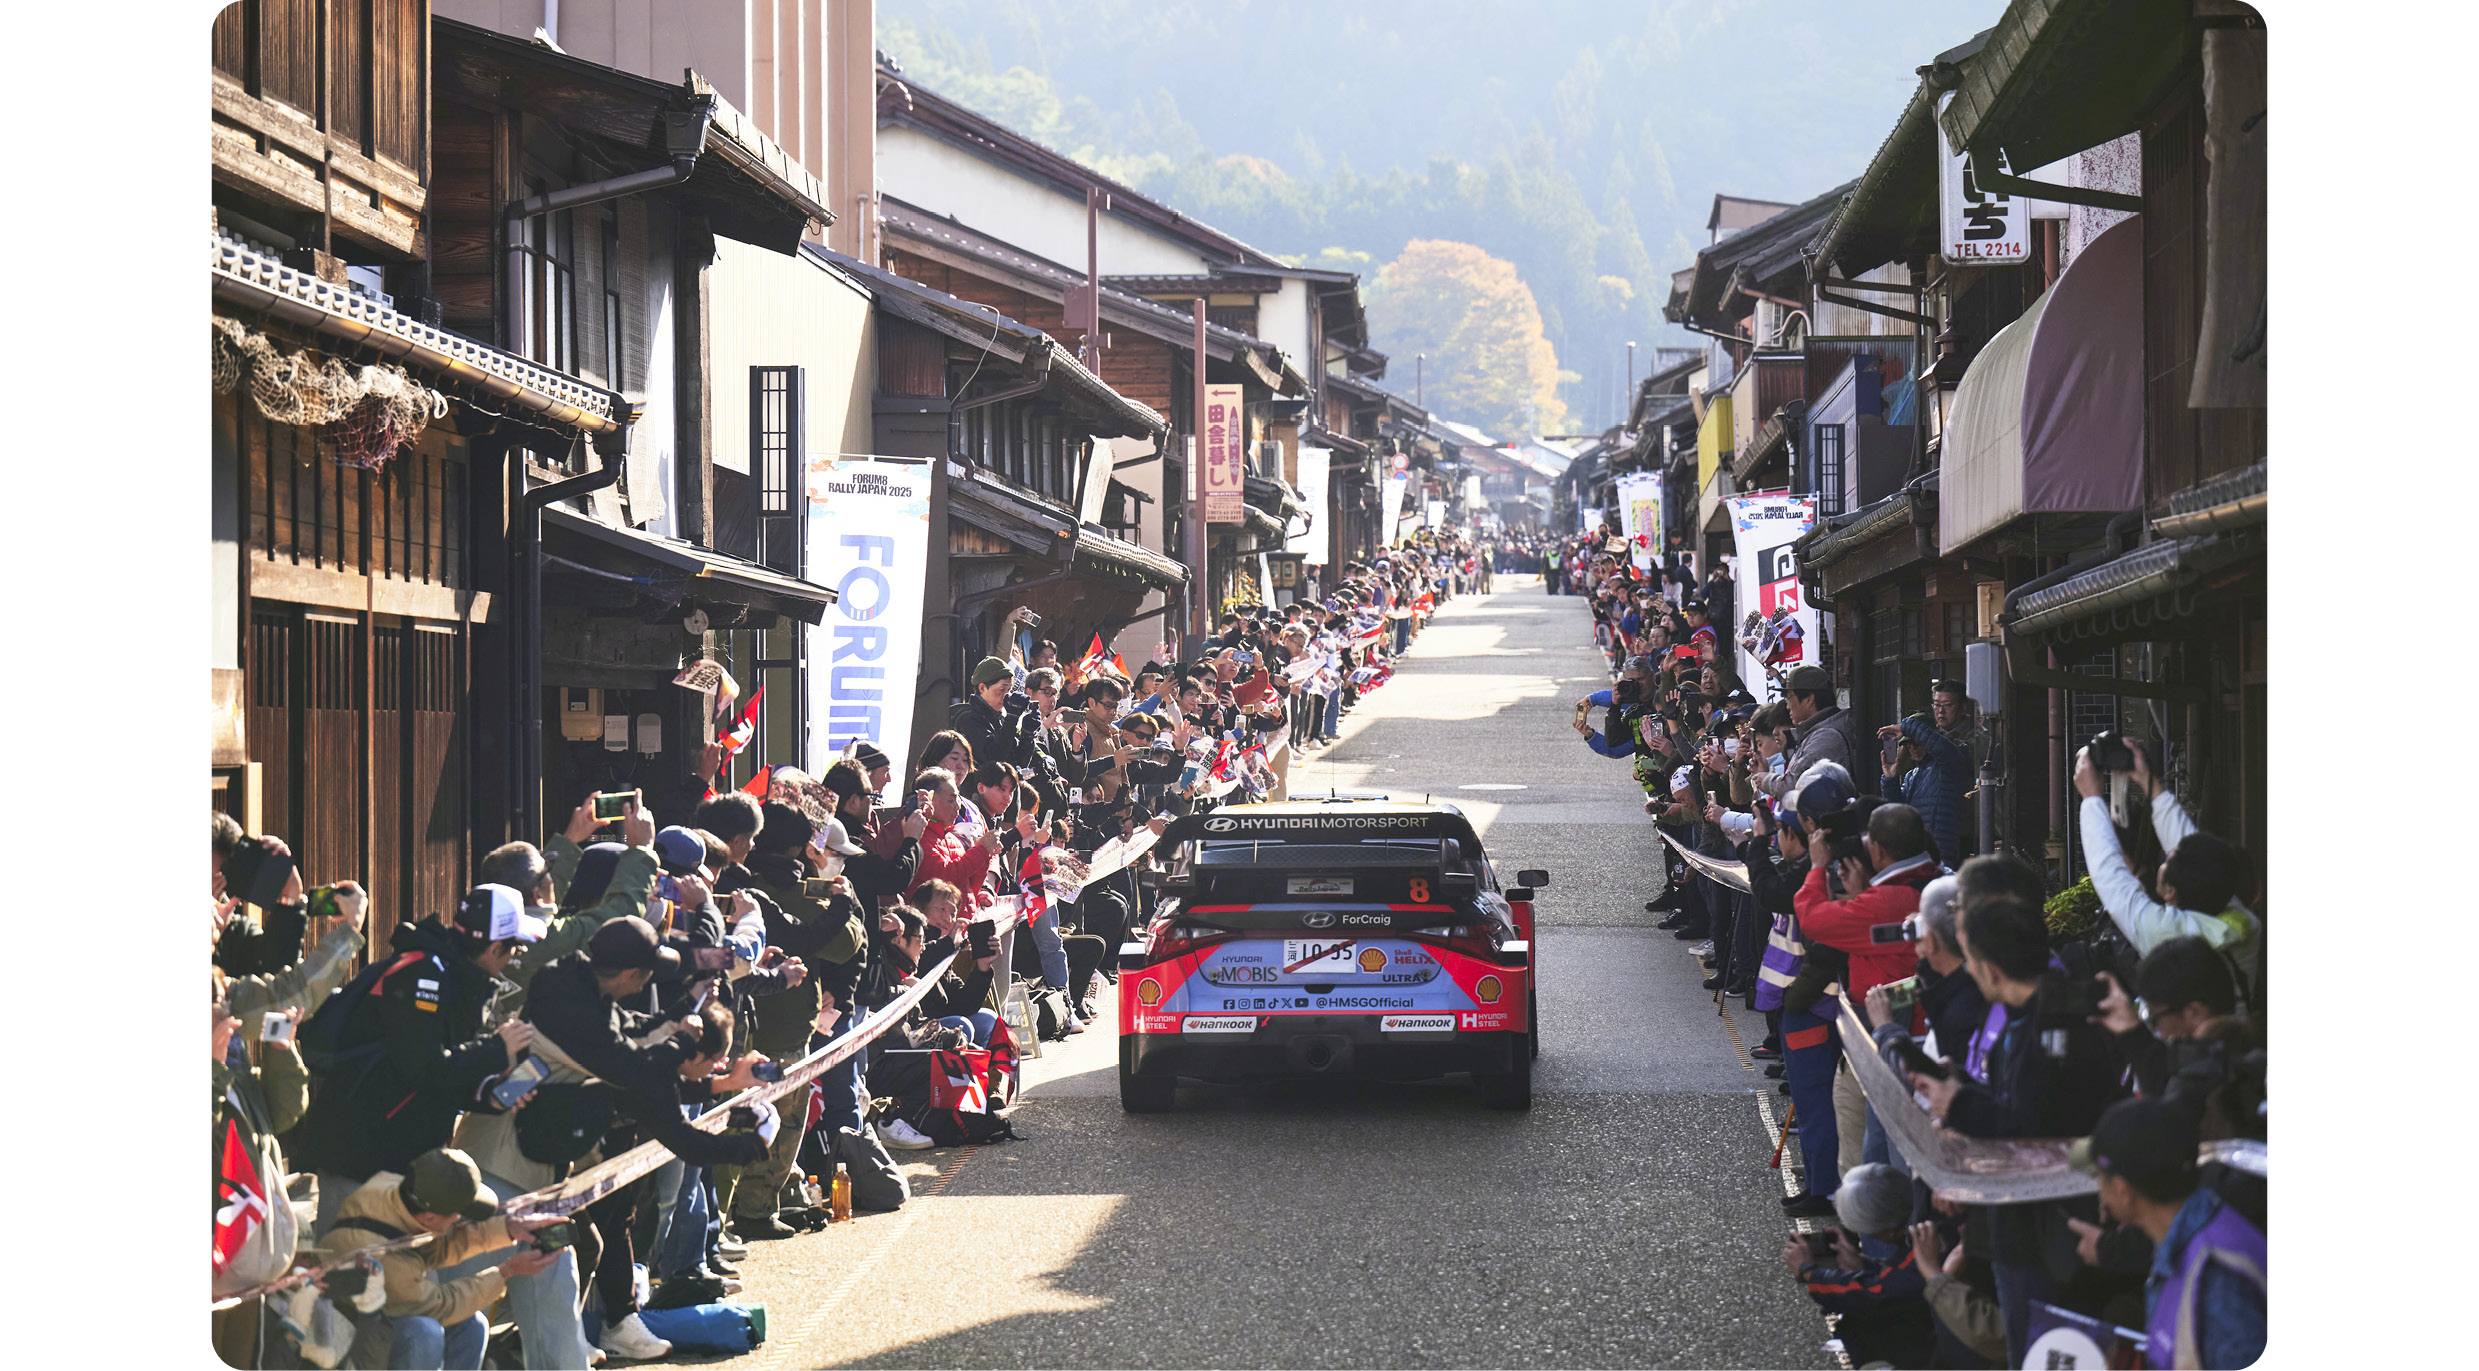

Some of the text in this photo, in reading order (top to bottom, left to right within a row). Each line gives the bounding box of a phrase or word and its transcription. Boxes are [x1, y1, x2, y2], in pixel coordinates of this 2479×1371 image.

[1955, 243, 2021, 257] TEL 2214
[1208, 404, 1226, 486] 田舎暮し
[852, 474, 888, 485] FORUM8
[828, 482, 912, 497] RALLY JAPAN 2025
[827, 534, 894, 768] FORUM
[1241, 817, 1429, 829] HYUNDAI MOTORSPORT
[1409, 878, 1430, 903] 8
[1342, 914, 1391, 925] ForCraig
[1395, 956, 1434, 965] HELIX
[1221, 966, 1278, 982] MOBIS
[1383, 973, 1422, 982] ULTRA
[1316, 998, 1414, 1008] @HMSGOfficial
